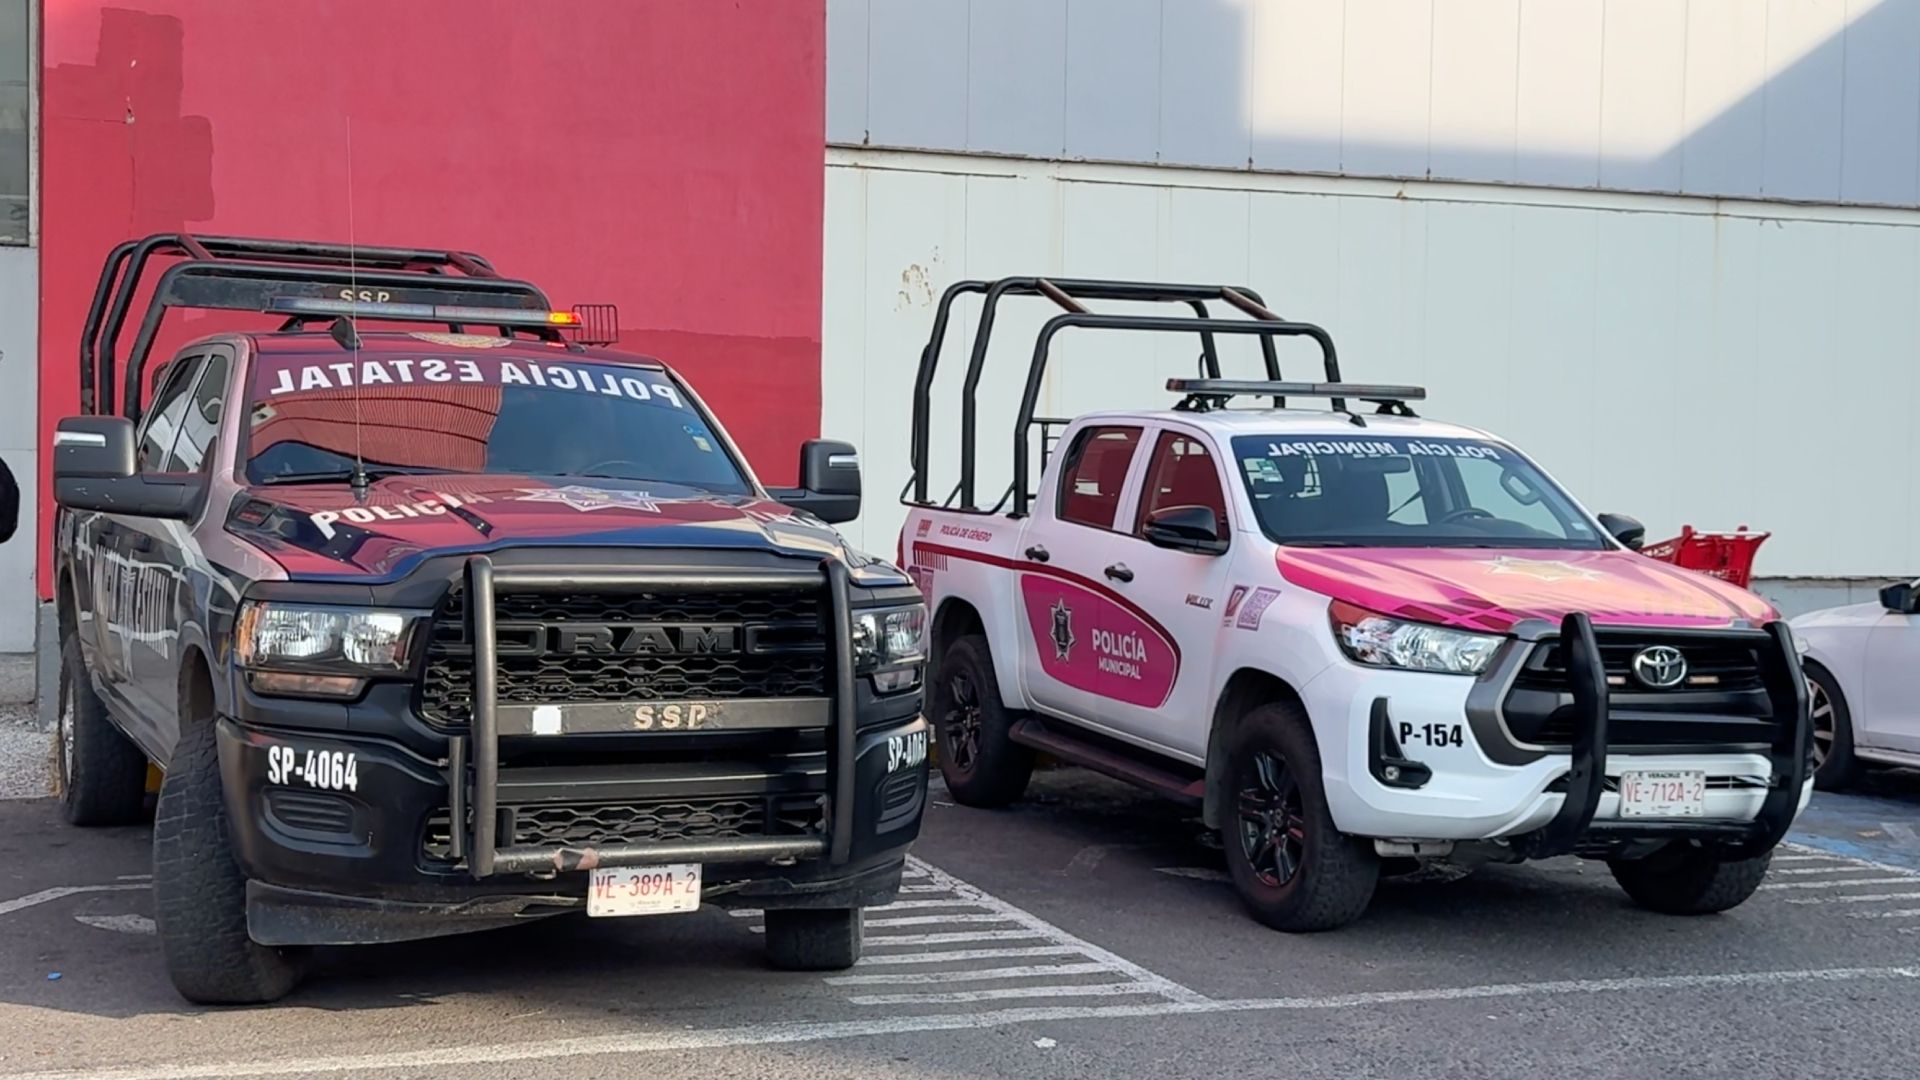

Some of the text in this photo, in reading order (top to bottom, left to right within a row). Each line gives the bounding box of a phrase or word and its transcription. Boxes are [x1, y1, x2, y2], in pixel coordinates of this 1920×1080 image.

[556, 622, 741, 655] RAM
[1091, 628, 1148, 663] POLICÍA
[1098, 656, 1142, 680] MUNICIPAL
[1399, 721, 1464, 748] P-154
[267, 745, 358, 792] SP-4064
[1625, 781, 1702, 803] VE-712A-2
[595, 871, 697, 899] VE-389A-2
